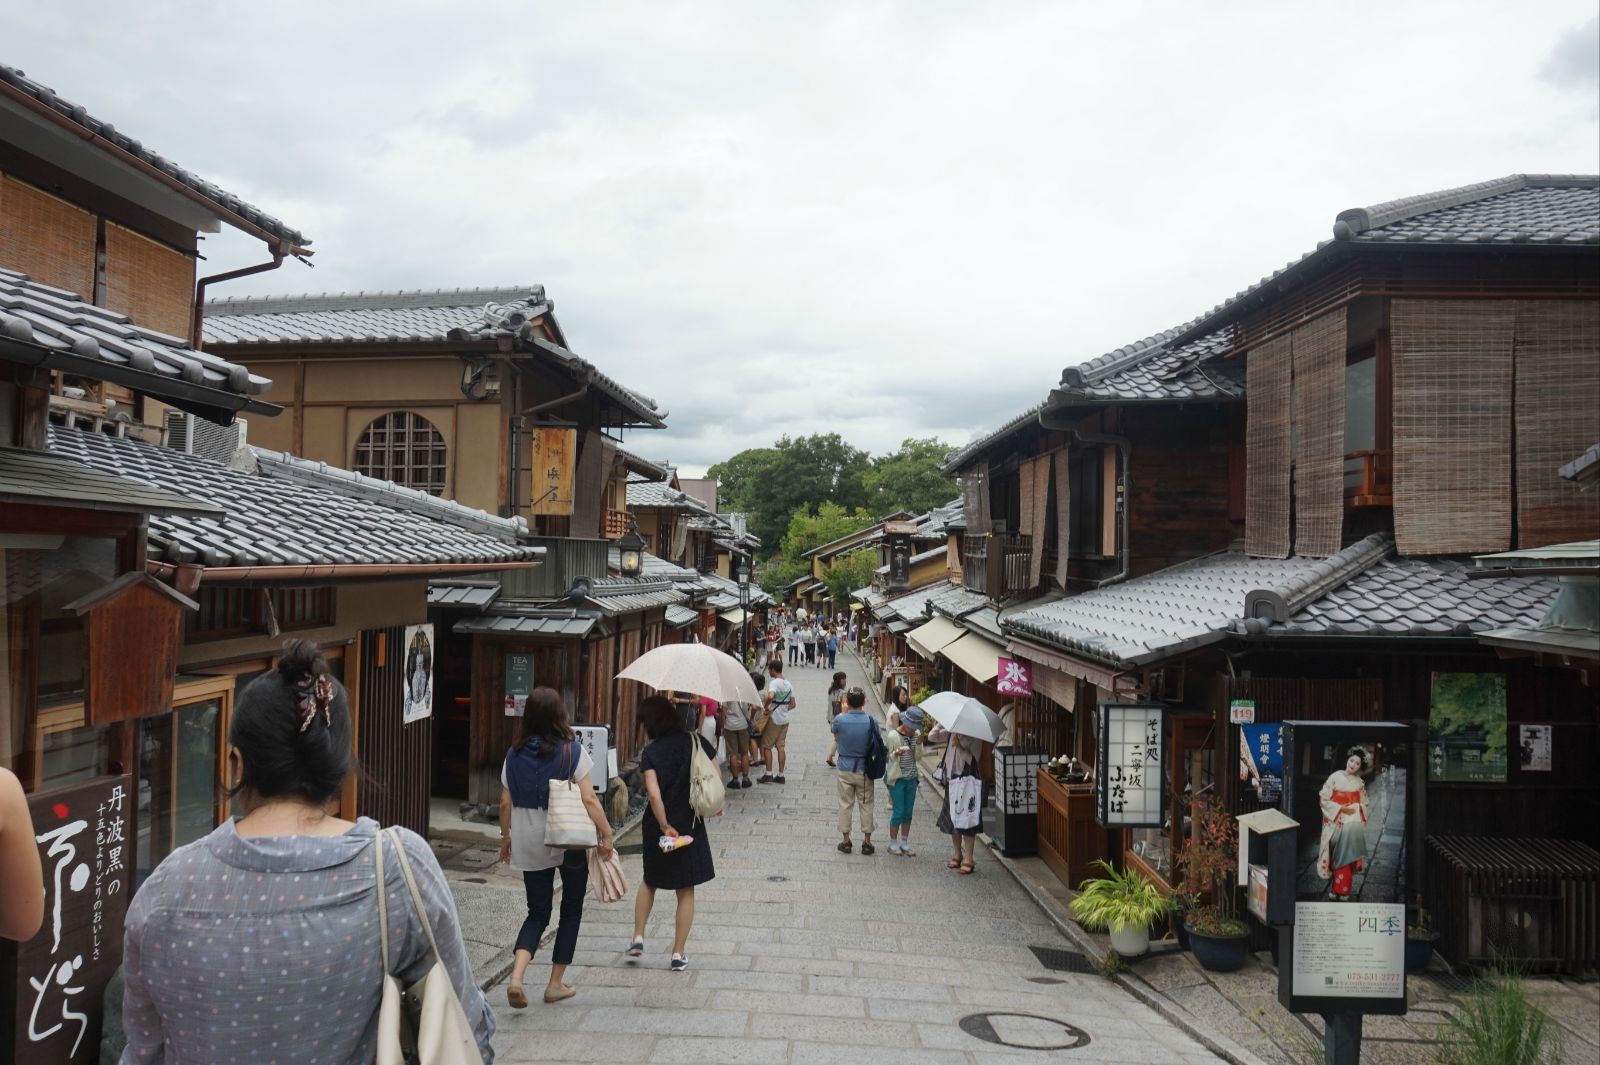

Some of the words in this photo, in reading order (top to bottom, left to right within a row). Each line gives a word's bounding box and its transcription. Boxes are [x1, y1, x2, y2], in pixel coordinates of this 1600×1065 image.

[512, 656, 528, 665] TEA
[1004, 661, 1027, 683] 氷
[1145, 719, 1159, 761] そば処
[1110, 766, 1128, 813] ふたば
[105, 785, 127, 896] 丹波黒の
[92, 802, 107, 961] 十五色よりどりのおいしさ
[1358, 916, 1402, 937] 四季
